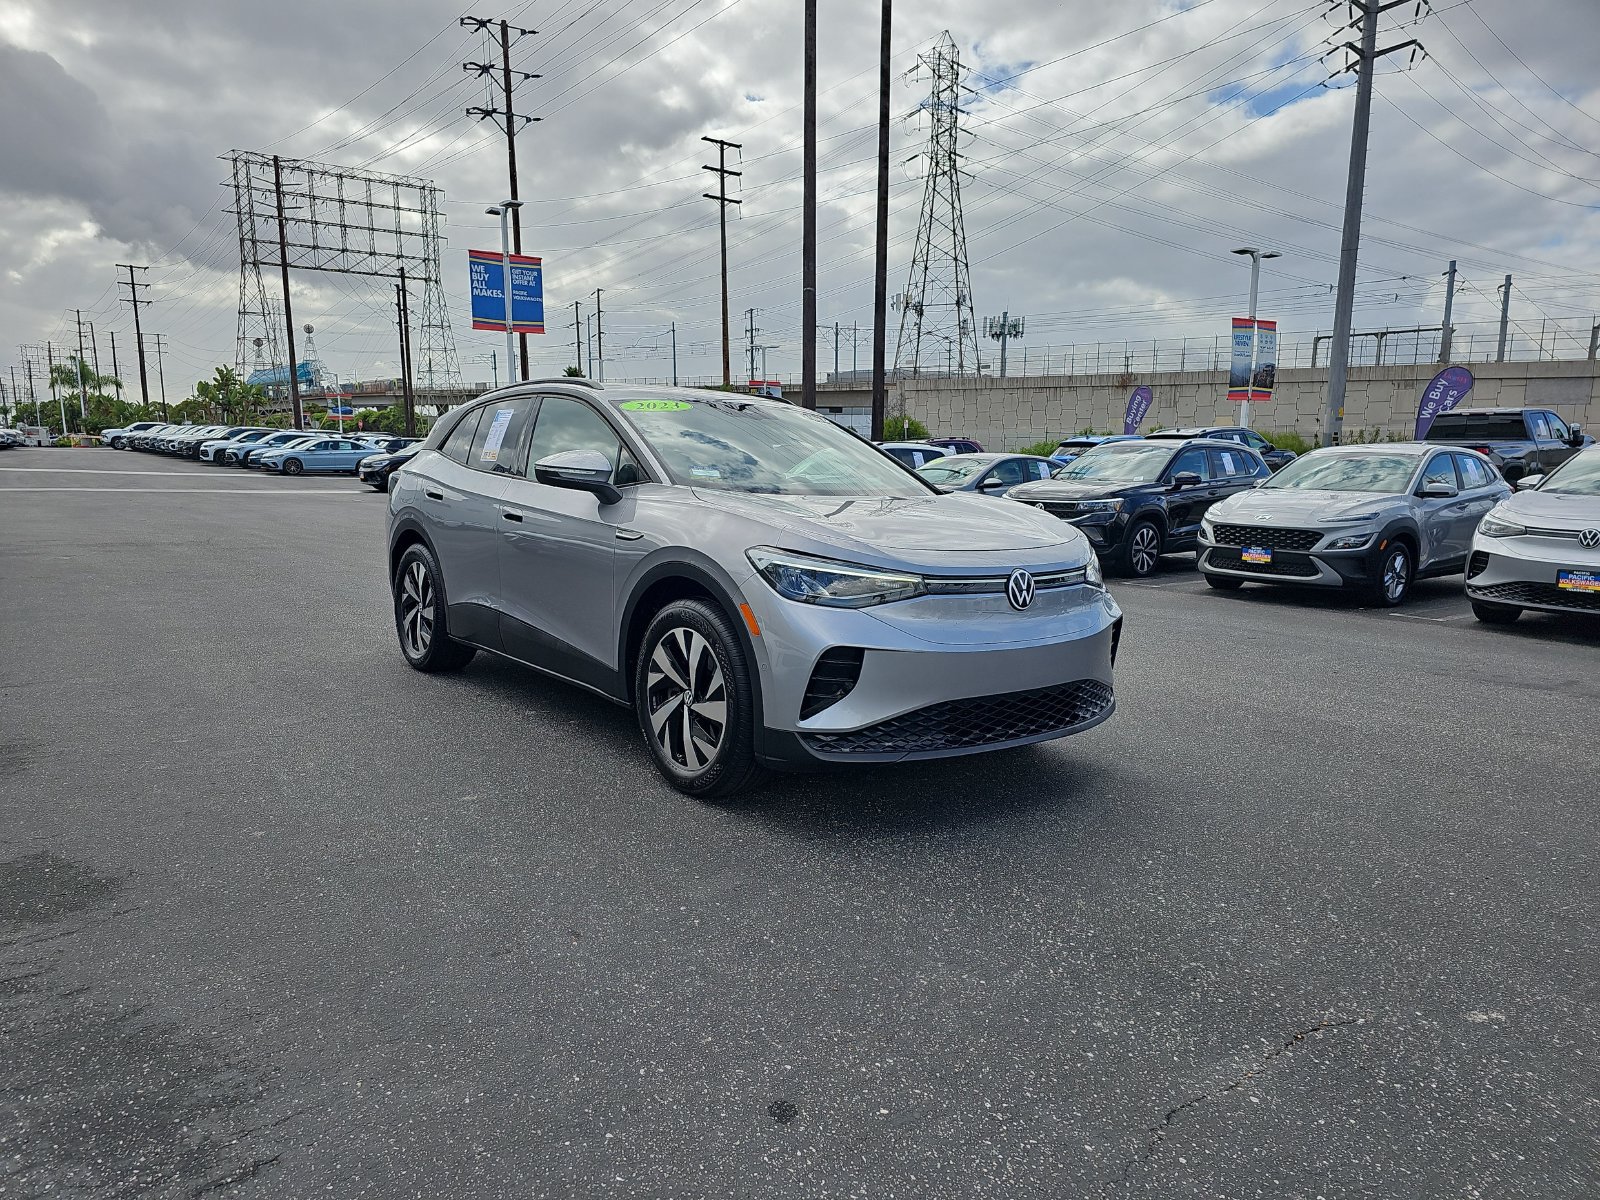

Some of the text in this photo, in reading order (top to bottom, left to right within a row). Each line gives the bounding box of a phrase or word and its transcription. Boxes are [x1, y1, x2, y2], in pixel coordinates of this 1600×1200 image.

[471, 264, 485, 273] WE
[472, 273, 490, 281] BUY
[472, 280, 488, 289] ALL
[472, 288, 504, 298] MAKES.
[1420, 378, 1449, 418] We Buy
[1438, 390, 1458, 412] Cars
[1126, 394, 1142, 424] Buying
[1133, 399, 1148, 428] Center
